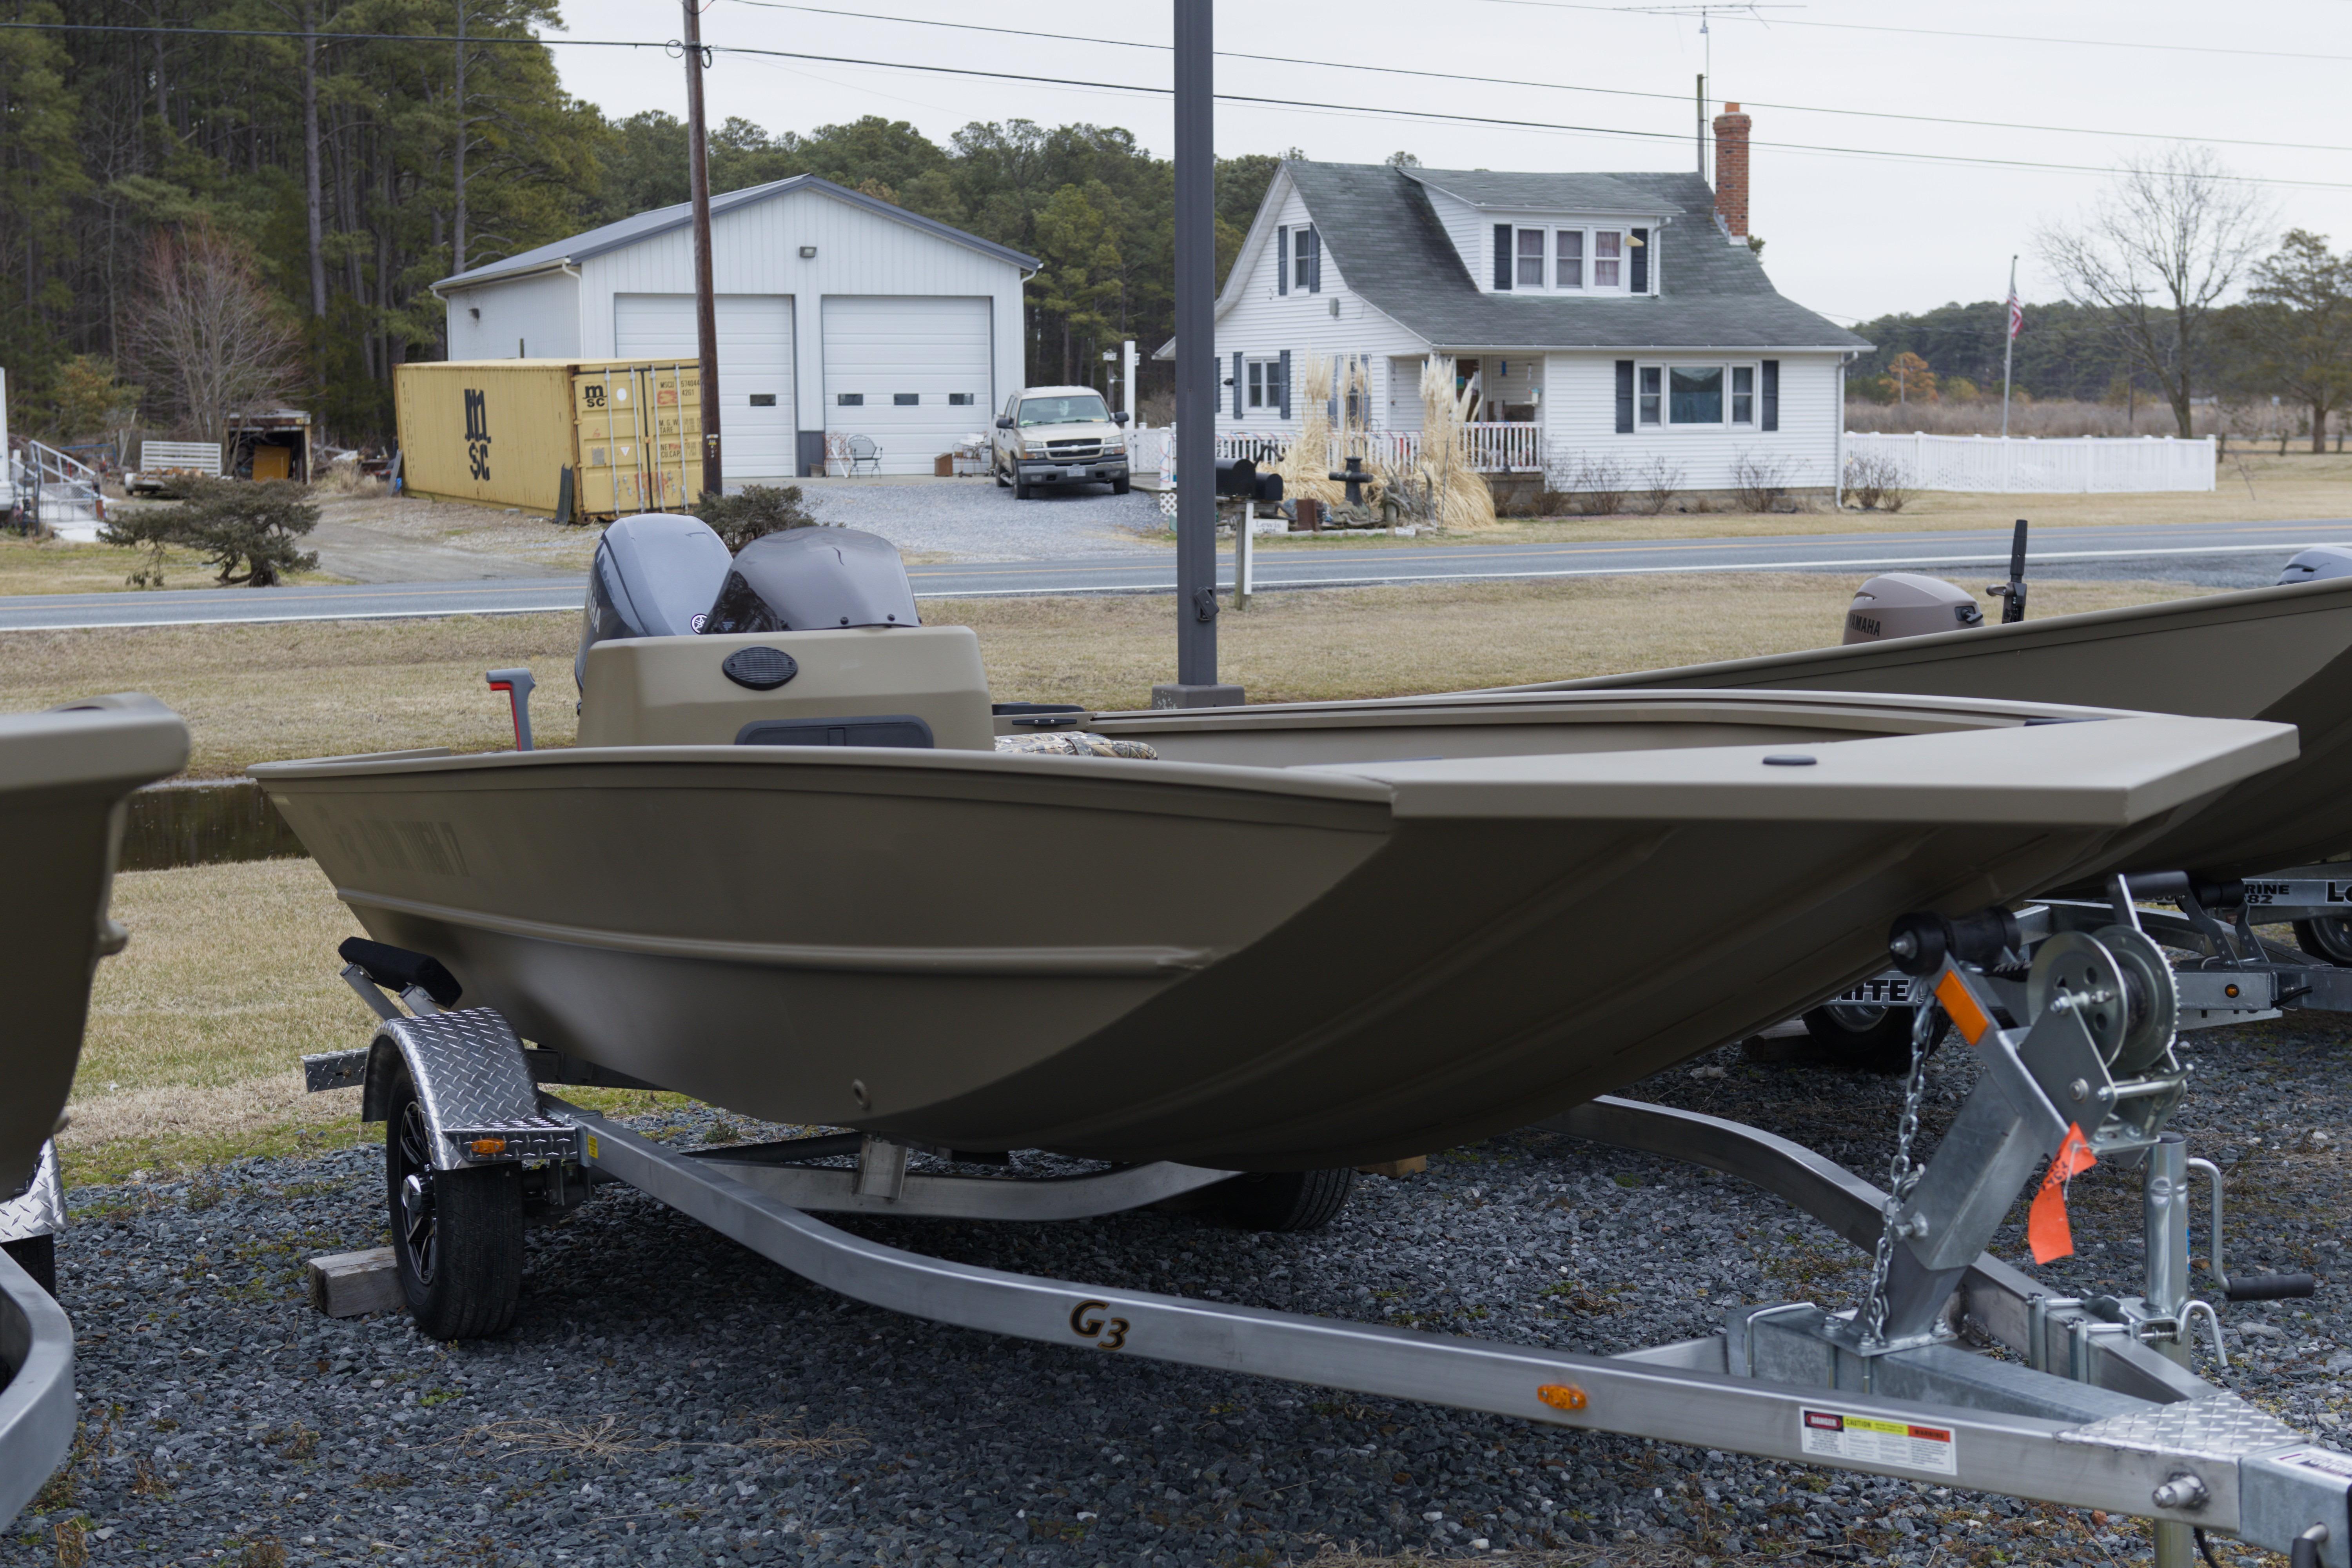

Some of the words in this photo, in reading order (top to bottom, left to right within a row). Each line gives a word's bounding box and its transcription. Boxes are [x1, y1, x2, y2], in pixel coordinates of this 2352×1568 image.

[1849, 613, 1880, 637] YAMAHA
[2245, 884, 2290, 895] RINE
[2245, 895, 2273, 904] 82
[1069, 1299, 1130, 1351] G3
[1811, 1416, 1837, 1427] DANGER
[1846, 1418, 1871, 1428] CAUTION
[1915, 1429, 1944, 1439] WARNING
